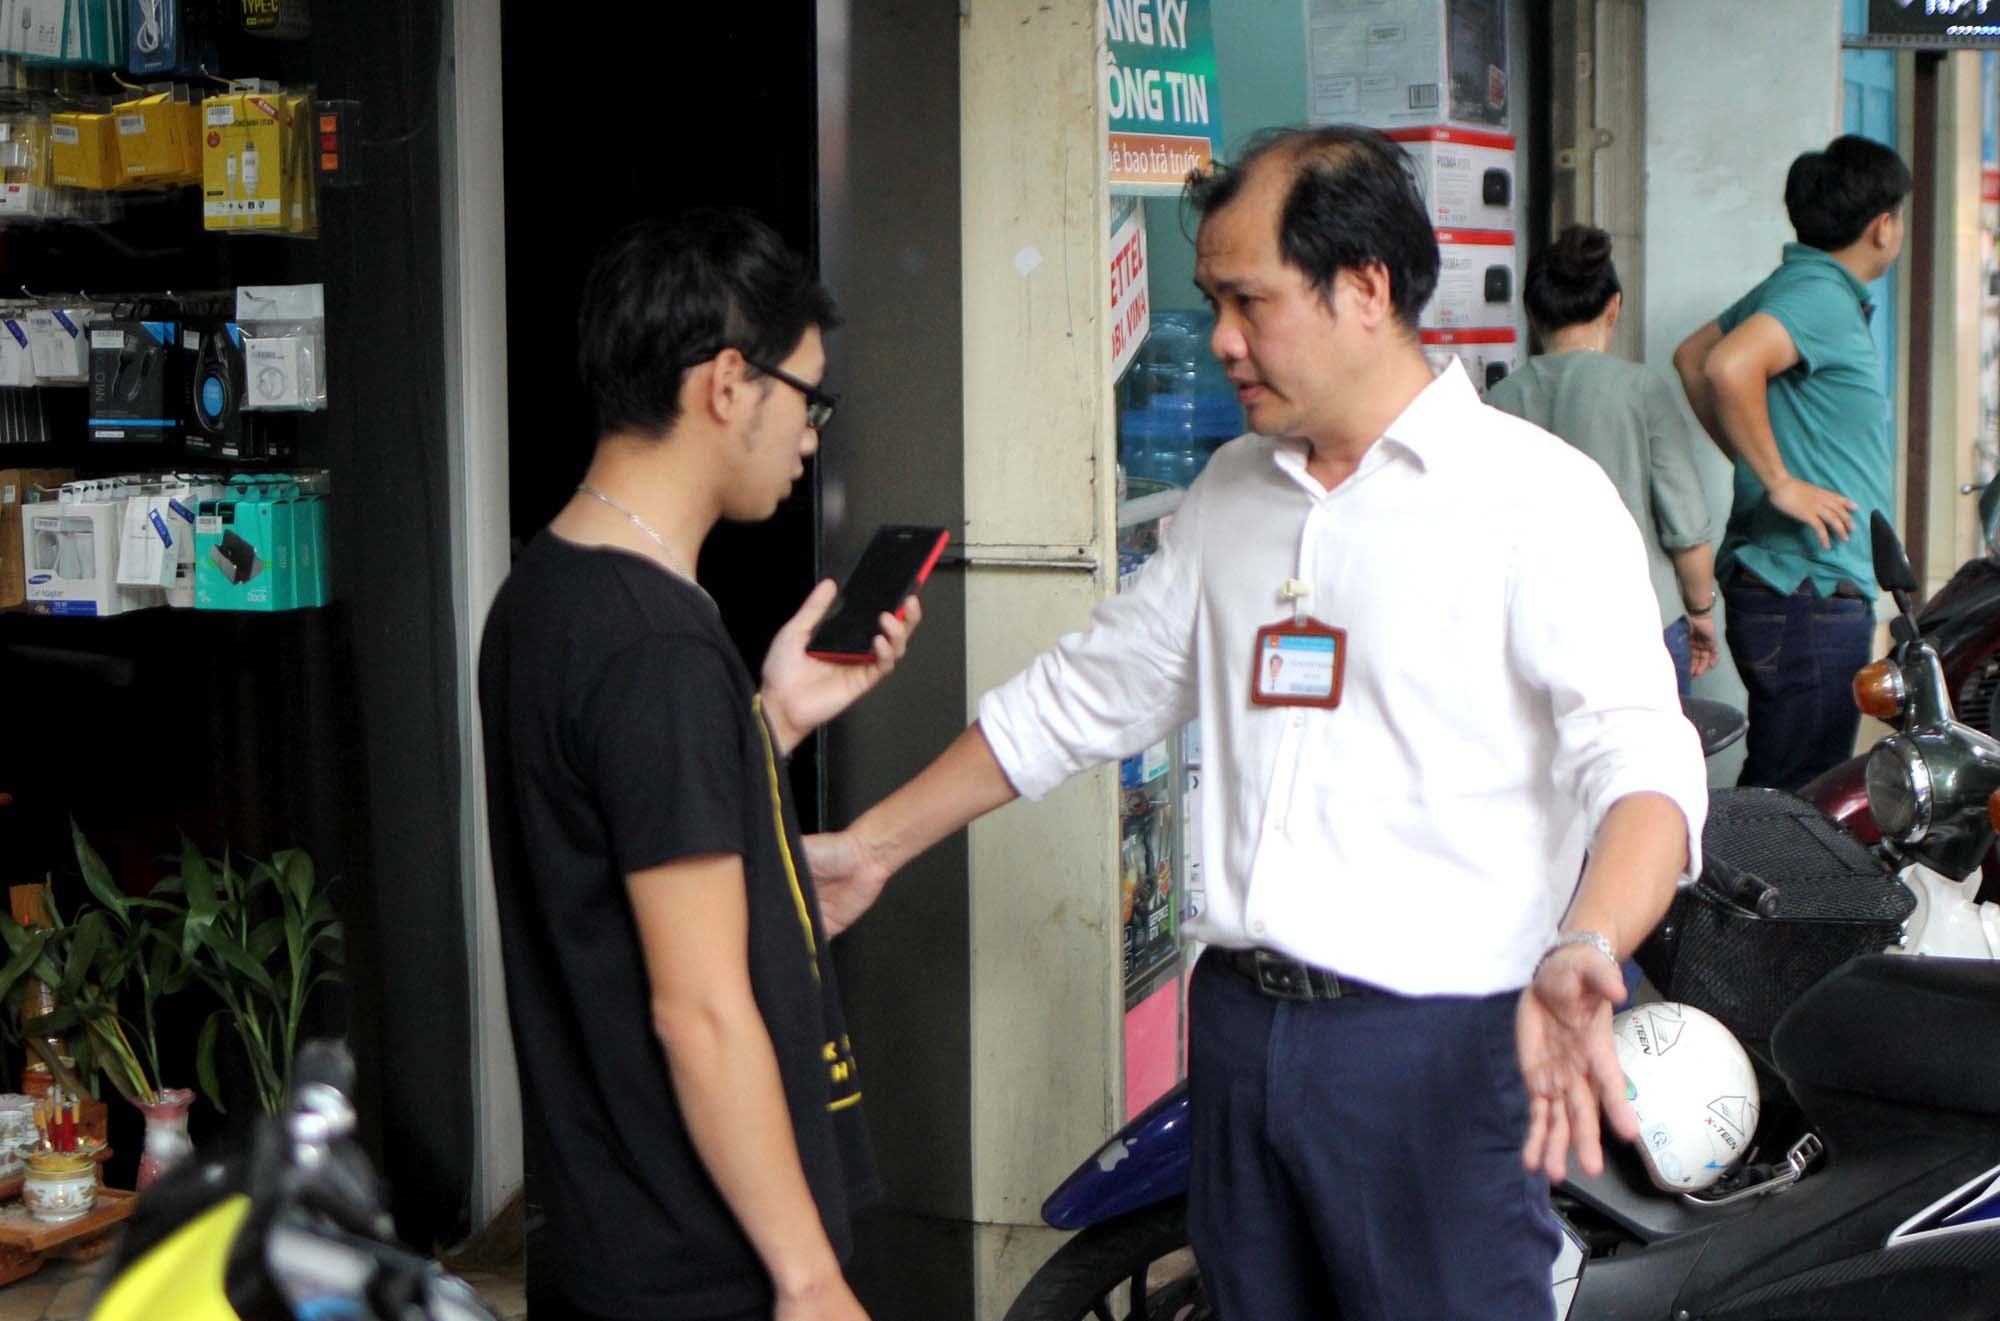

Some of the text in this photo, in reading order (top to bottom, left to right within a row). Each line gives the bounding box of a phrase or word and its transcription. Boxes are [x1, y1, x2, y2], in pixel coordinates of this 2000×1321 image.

[1165, 71, 1209, 124] TIN
[1122, 142, 1148, 174] bao
[1150, 144, 1168, 174] trả
[1703, 1116, 1739, 1151] X-TEEN
